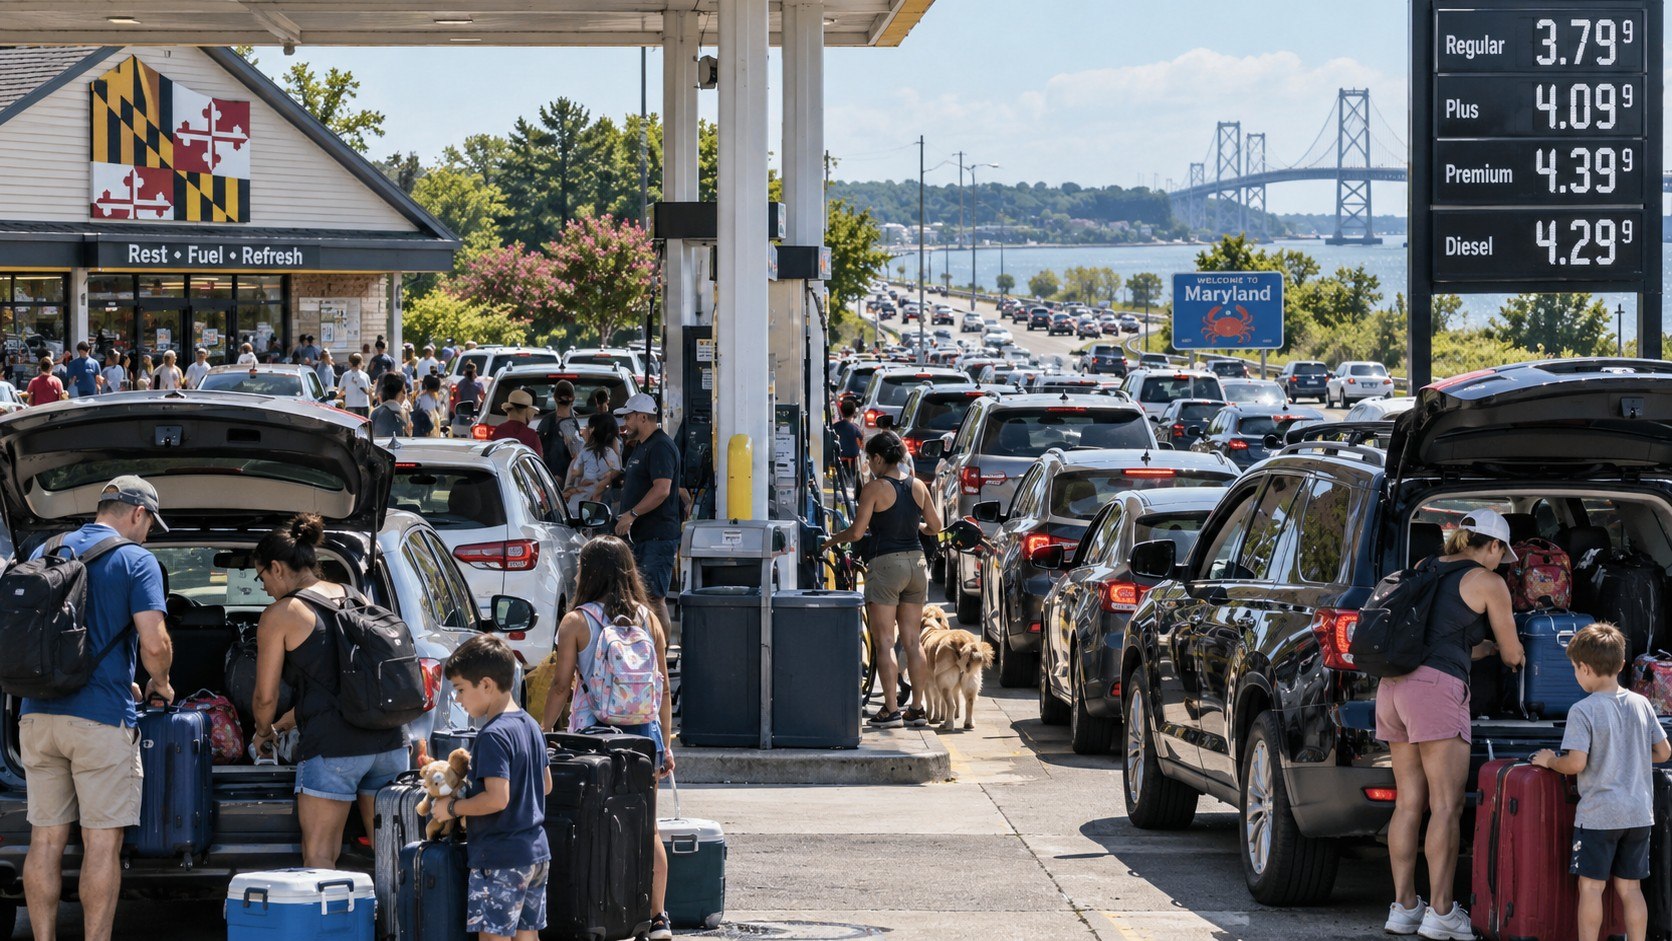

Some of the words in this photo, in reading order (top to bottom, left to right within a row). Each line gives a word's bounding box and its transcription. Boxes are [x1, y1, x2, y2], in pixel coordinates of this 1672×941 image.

[1446, 35, 1505, 60] Regular
[1446, 99, 1479, 119] Plus
[1446, 164, 1513, 184] Premium
[128, 244, 168, 263] Rest
[188, 245, 224, 264] Fuel
[242, 246, 303, 265] Refresh
[1446, 236, 1493, 256] Diesel
[1247, 276, 1258, 284] TO
[1184, 285, 1271, 304] Maryland
